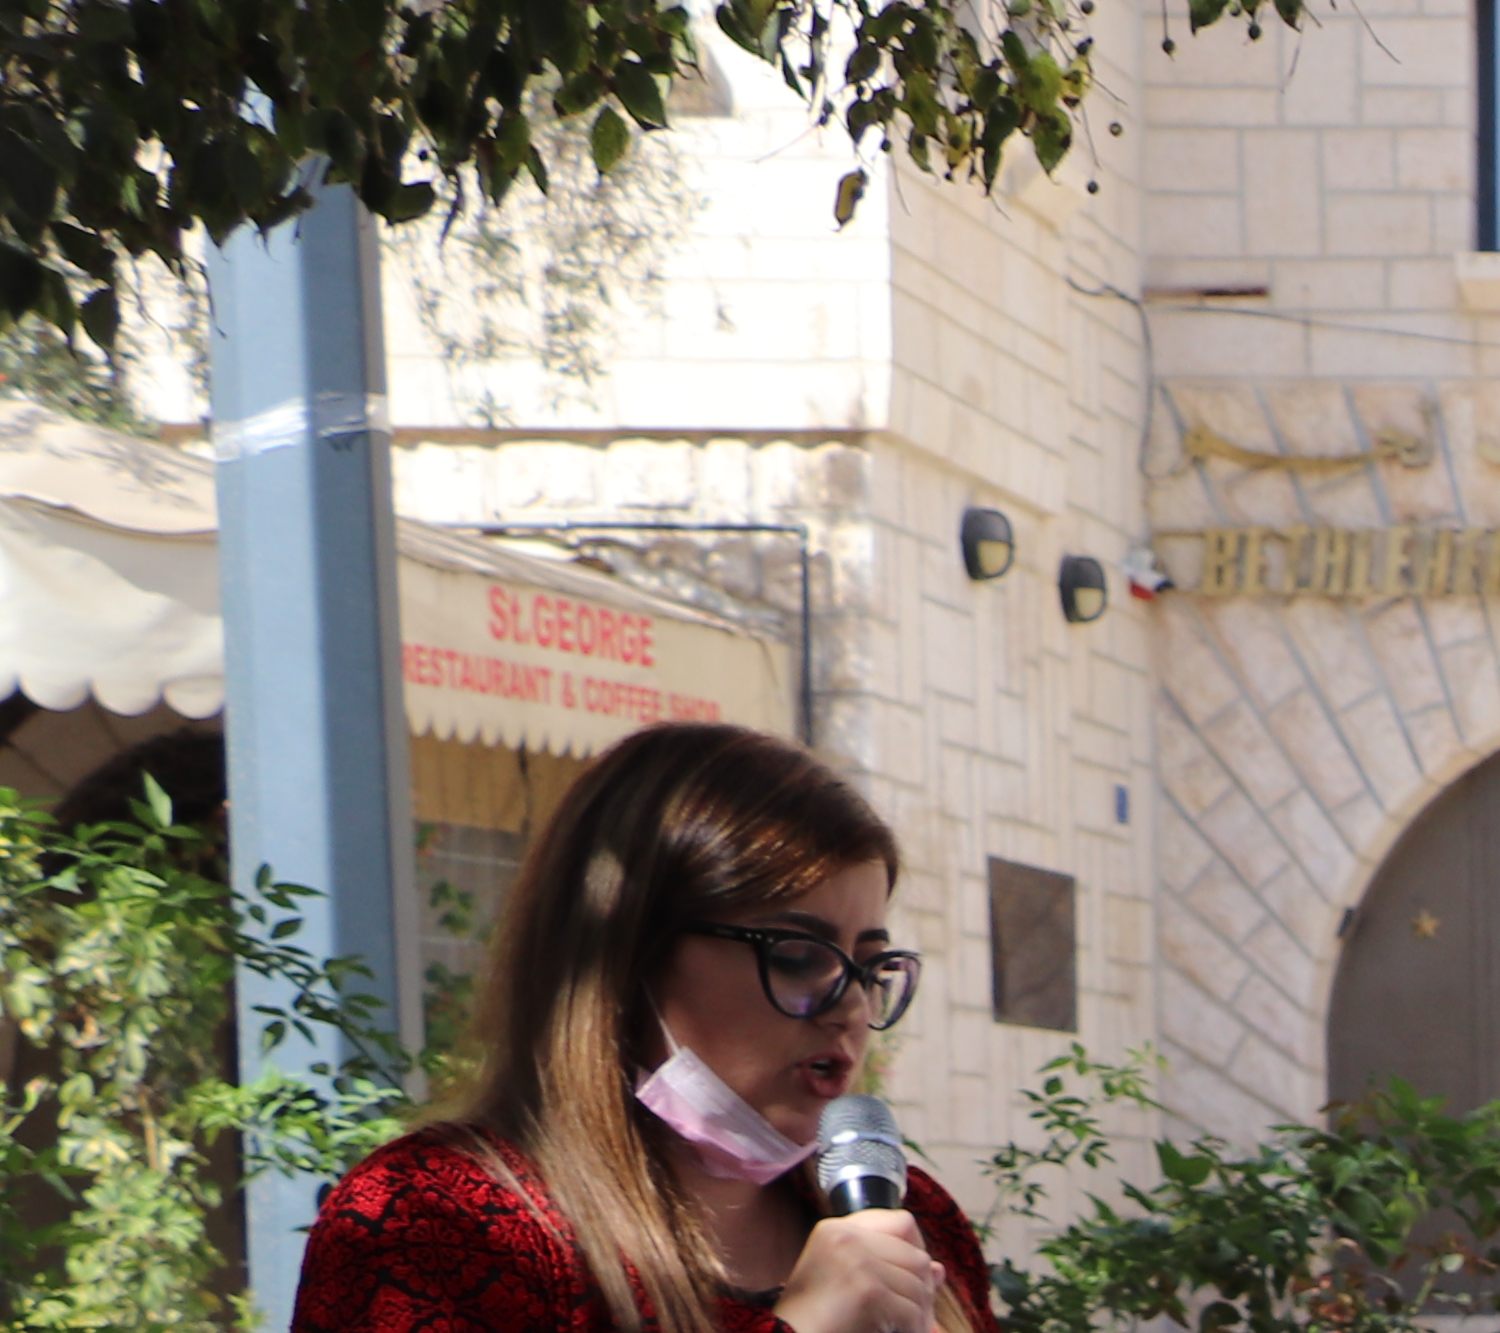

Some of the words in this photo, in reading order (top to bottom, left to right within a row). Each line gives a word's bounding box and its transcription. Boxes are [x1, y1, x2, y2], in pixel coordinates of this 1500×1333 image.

[402, 642, 552, 705] RESTAURANT
[561, 672, 576, 708] &
[583, 681, 662, 724] COFFEE
